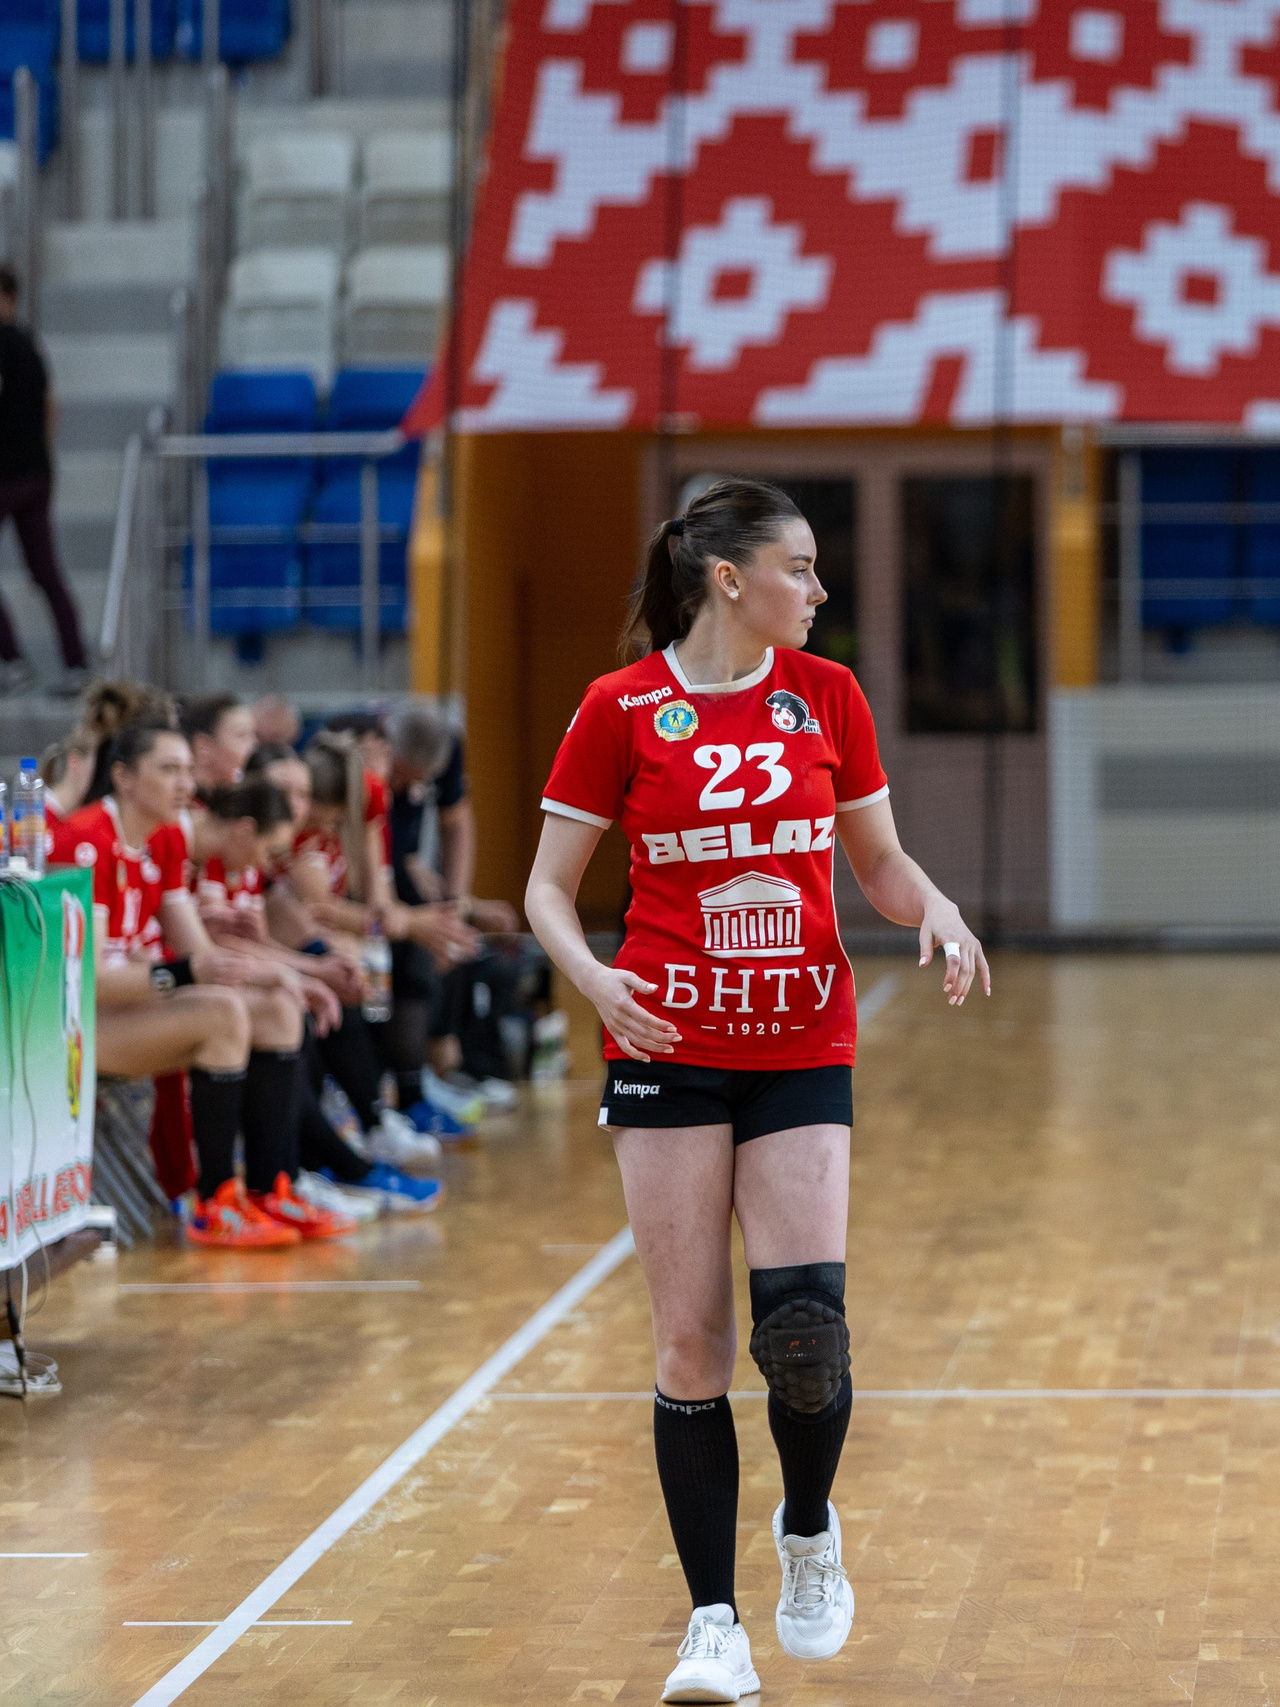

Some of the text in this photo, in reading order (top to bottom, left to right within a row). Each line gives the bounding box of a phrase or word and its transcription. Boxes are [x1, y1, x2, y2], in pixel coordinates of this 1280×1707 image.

[617, 685, 673, 711] Kempa
[693, 742, 792, 811] 23
[641, 814, 835, 865] BELAZ
[661, 963, 837, 1013] БНТУ
[726, 1022, 781, 1035] 1920
[613, 1080, 660, 1098] Kempa
